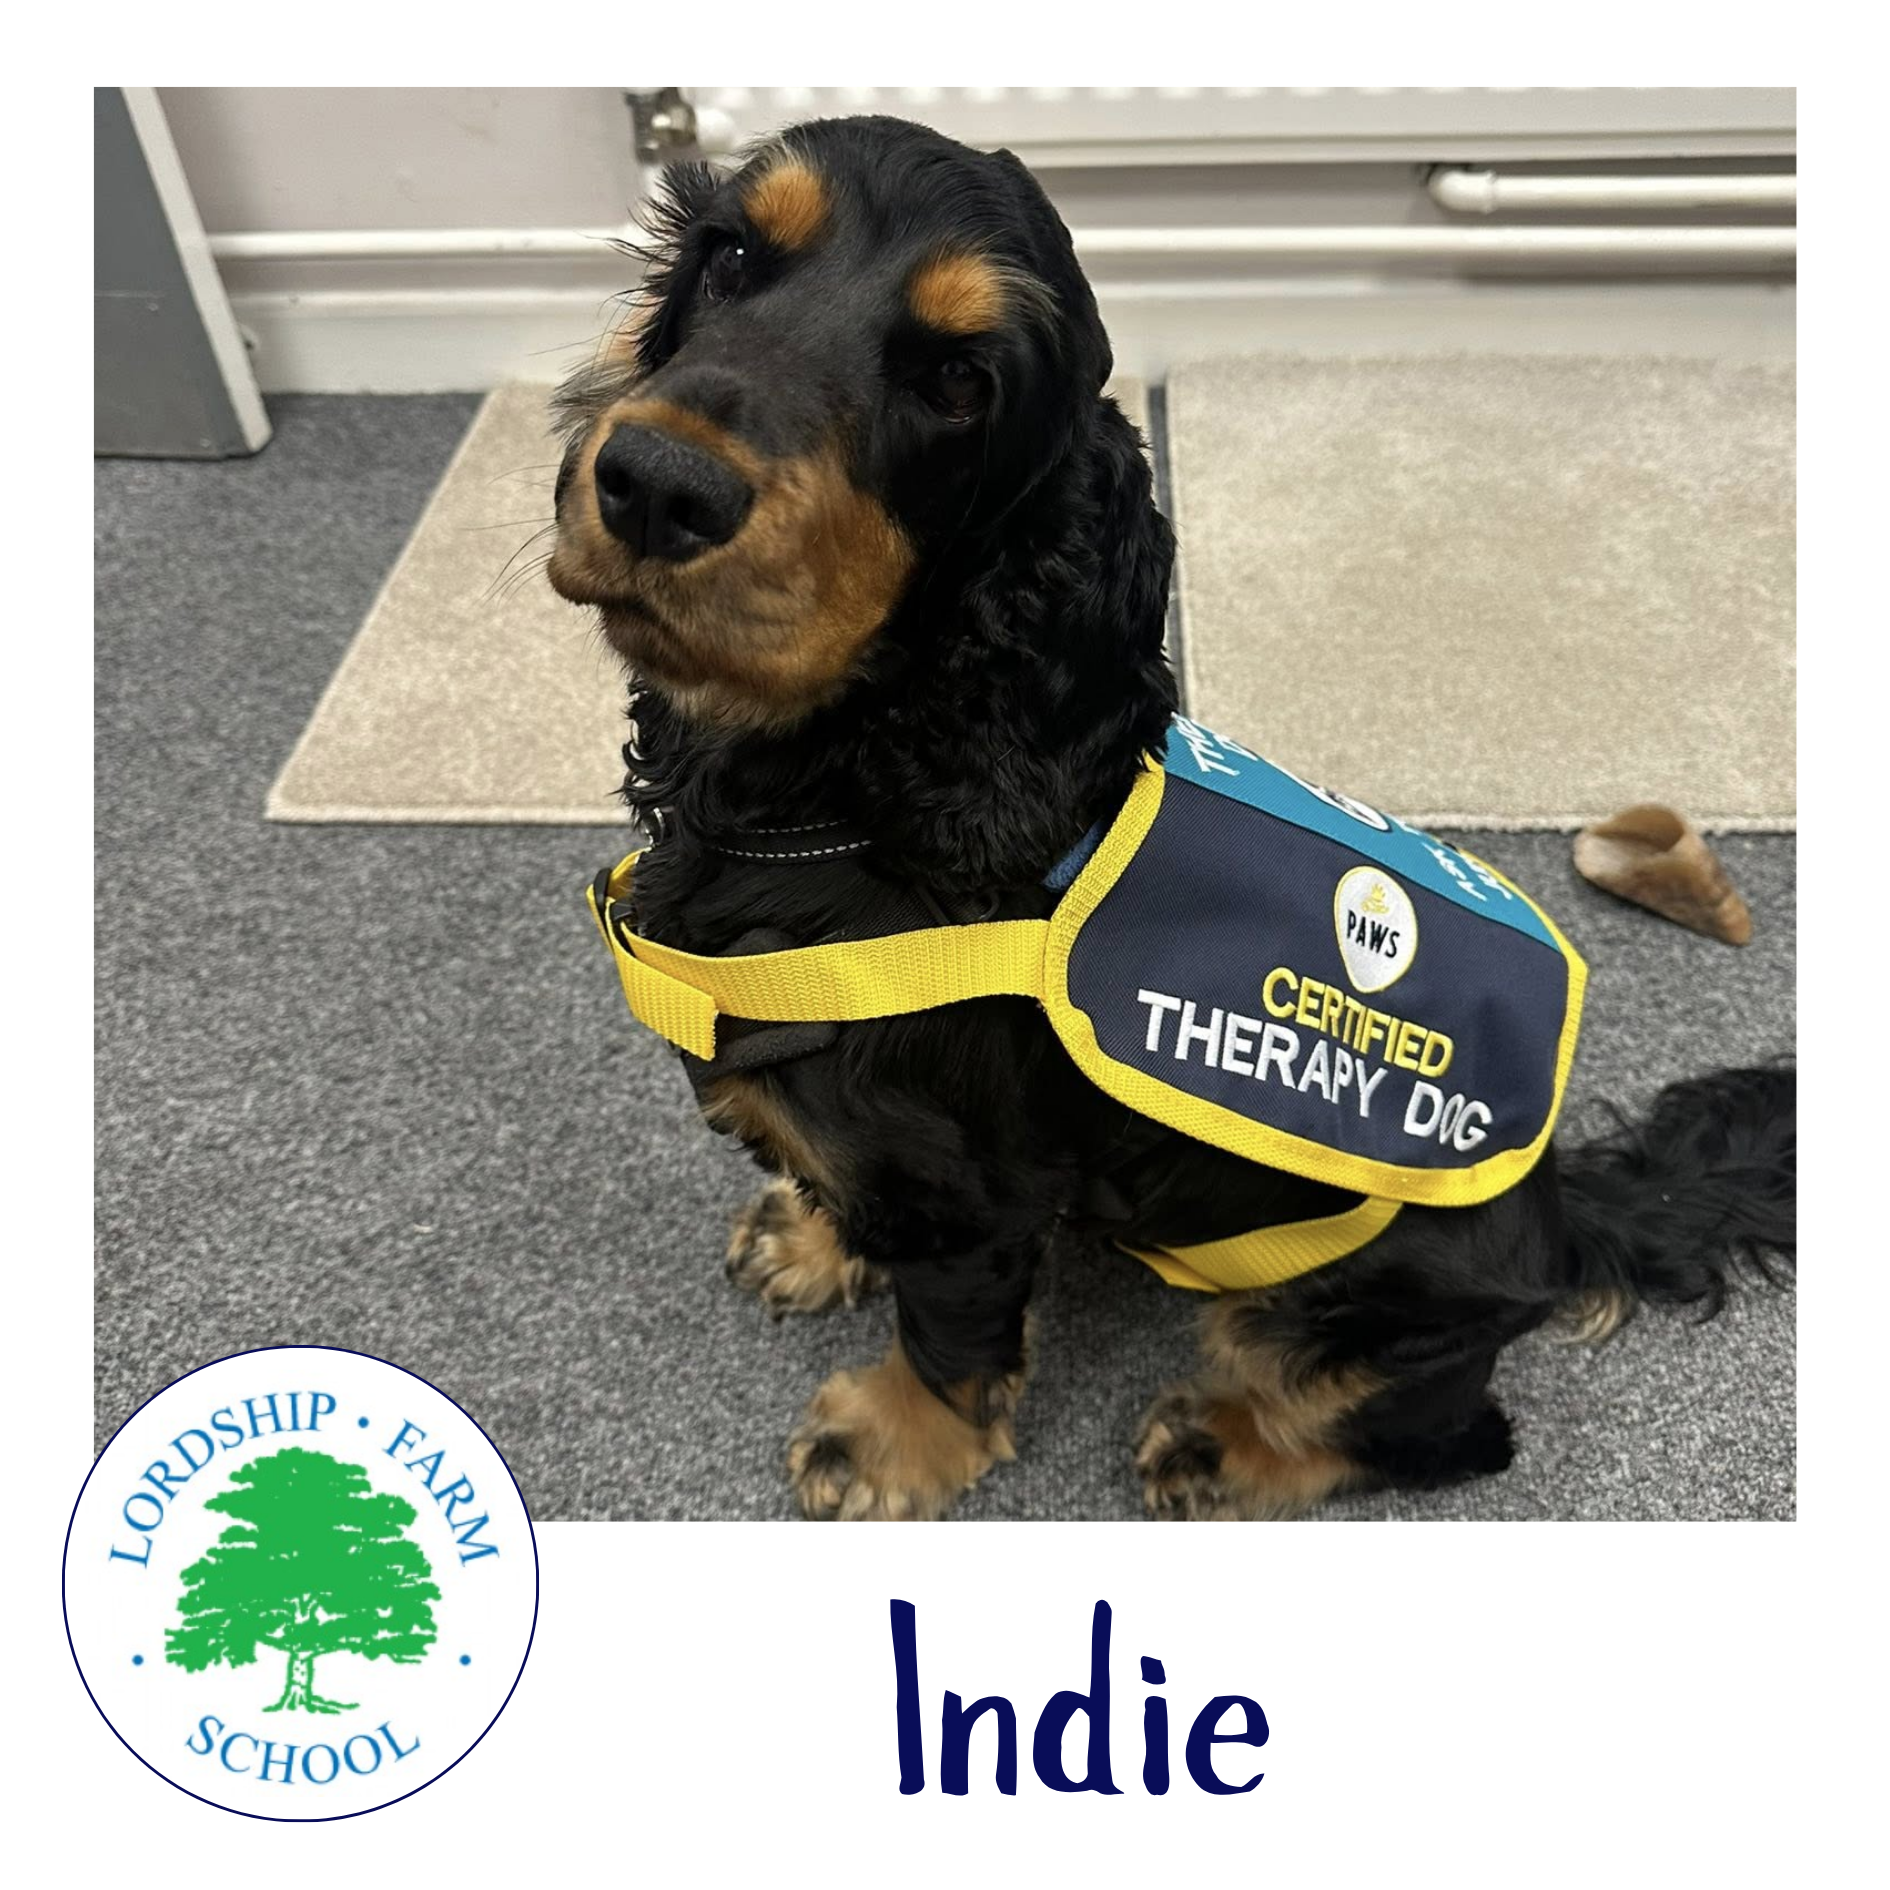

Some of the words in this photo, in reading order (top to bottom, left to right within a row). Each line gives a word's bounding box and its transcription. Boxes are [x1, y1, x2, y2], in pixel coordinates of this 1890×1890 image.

[1346, 909, 1401, 959] PAWS
[1136, 988, 1388, 1118] THERAPY
[1402, 1080, 1493, 1152] DOG
[1262, 966, 1455, 1078] CERTIFIED
